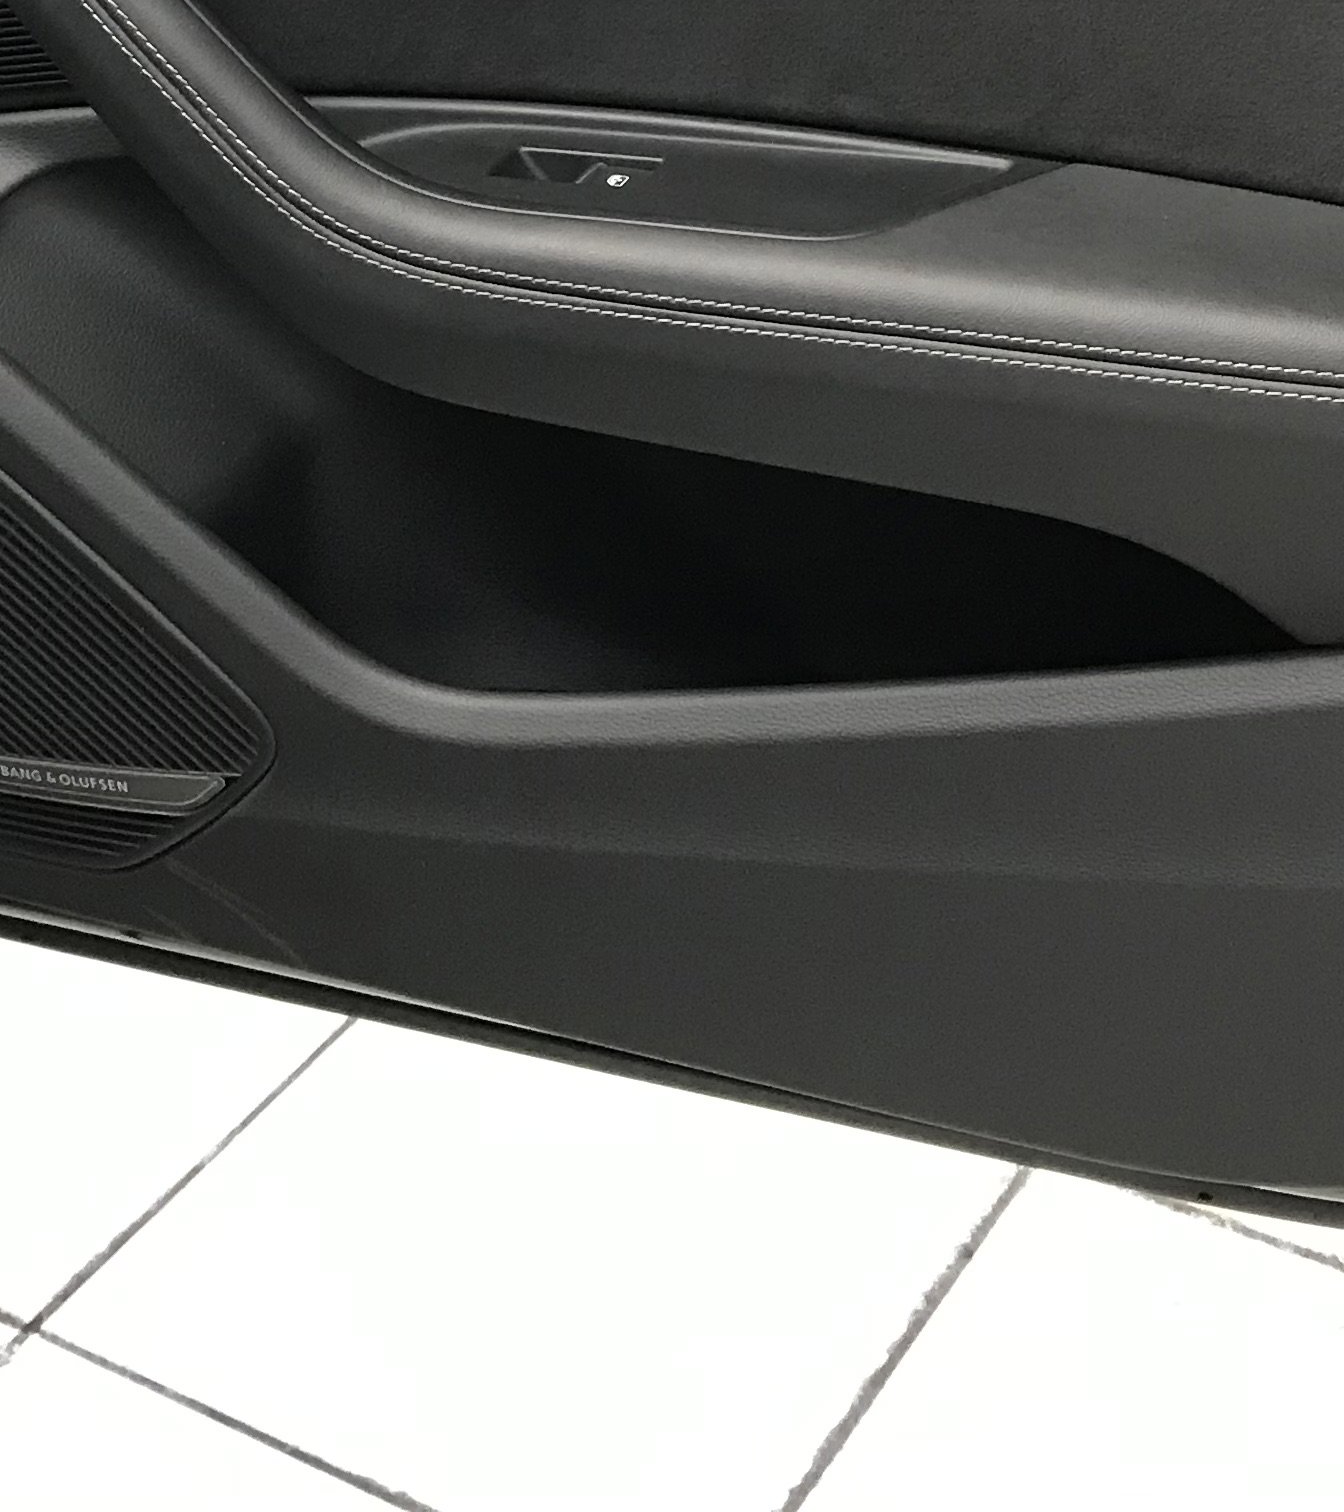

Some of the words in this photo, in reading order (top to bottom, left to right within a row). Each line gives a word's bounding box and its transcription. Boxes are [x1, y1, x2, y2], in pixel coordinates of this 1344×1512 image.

[0, 764, 42, 782] BANG
[46, 771, 57, 784] &
[58, 773, 129, 793] OLUFSEN
